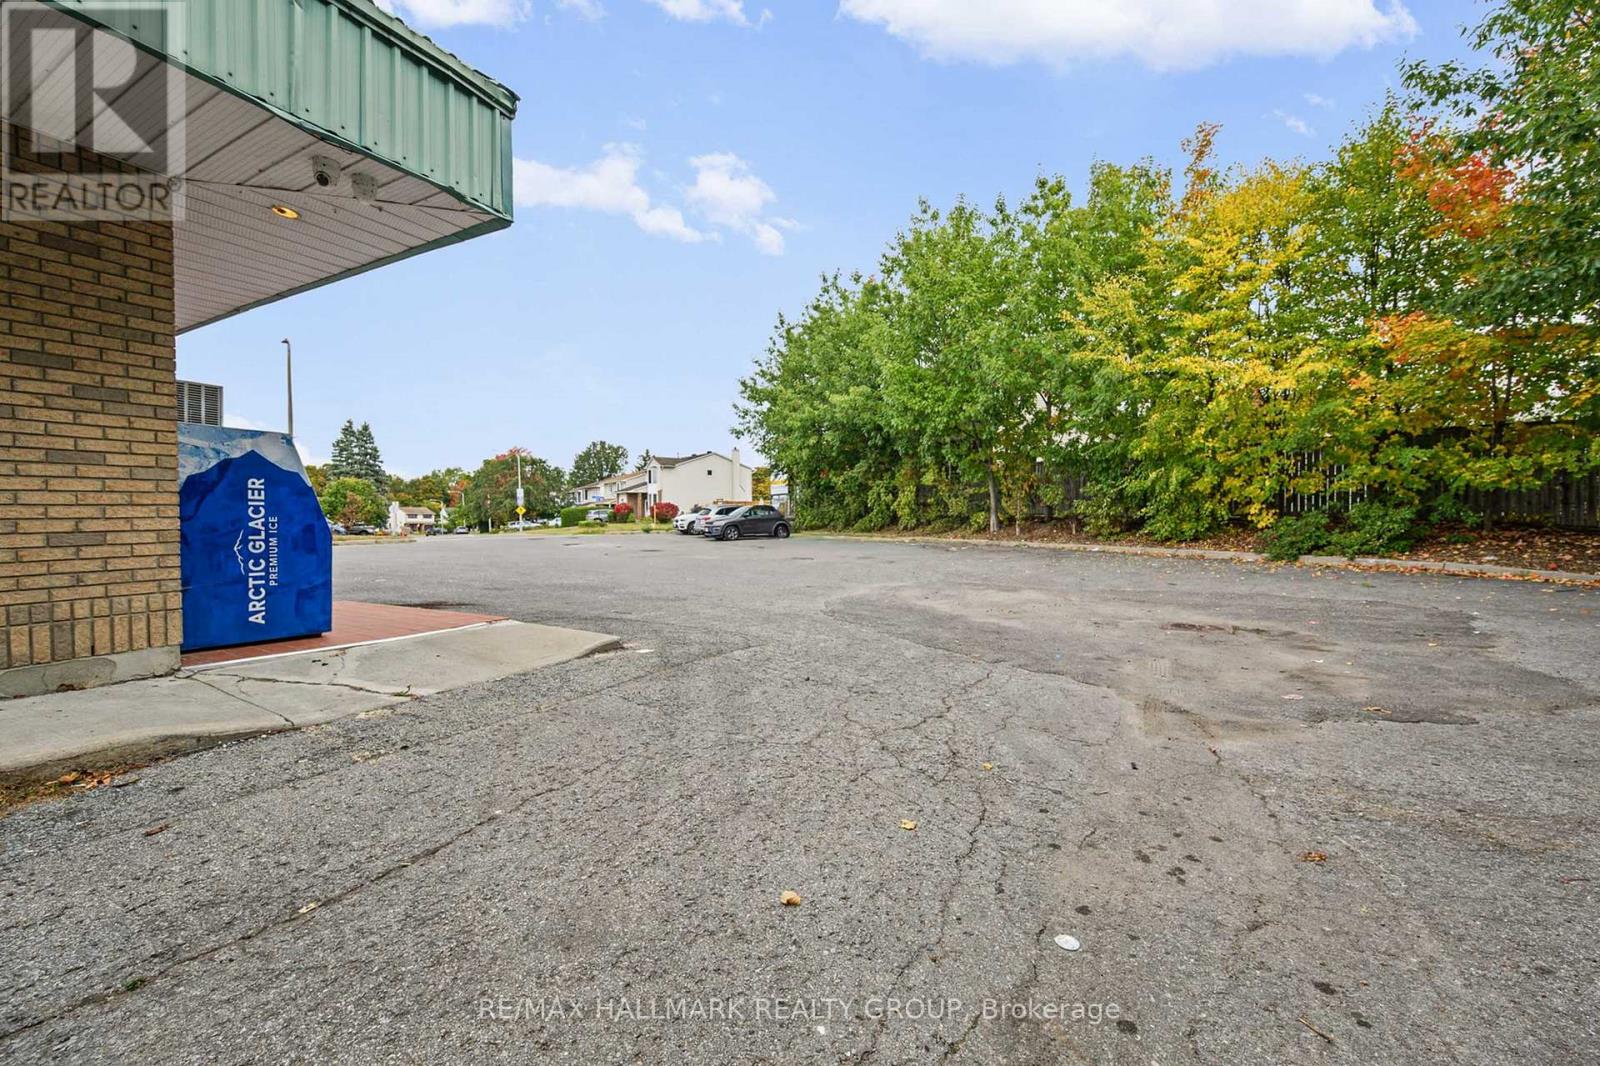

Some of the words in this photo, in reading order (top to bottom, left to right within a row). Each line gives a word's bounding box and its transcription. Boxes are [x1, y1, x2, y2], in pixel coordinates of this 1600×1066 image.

[247, 478, 266, 553] GLACIER
[268, 516, 278, 534] ICE
[269, 537, 279, 586] PREMIUM
[248, 558, 266, 624] ARCTIC
